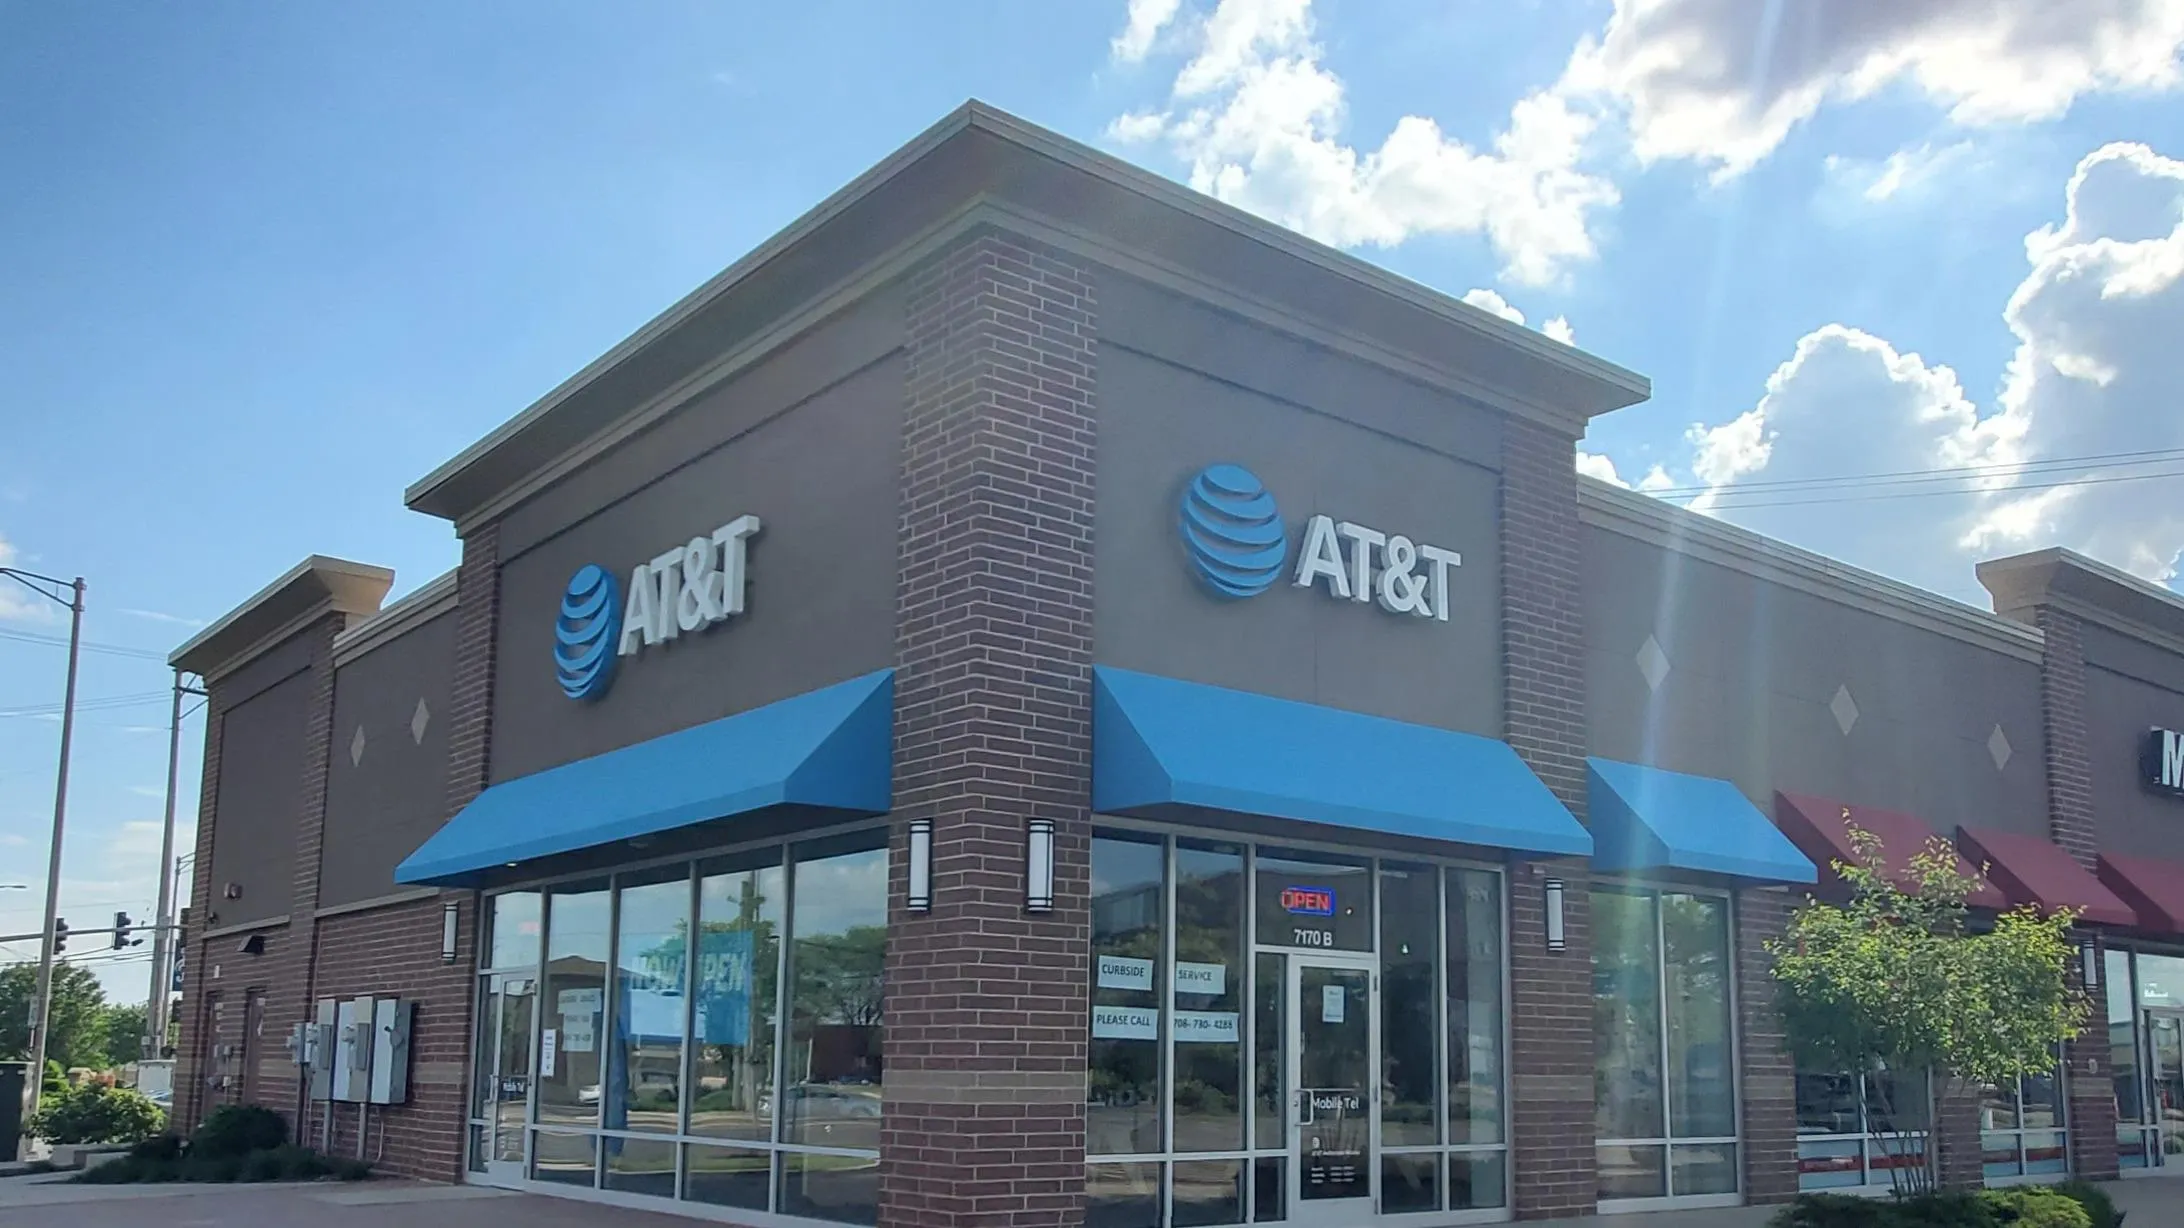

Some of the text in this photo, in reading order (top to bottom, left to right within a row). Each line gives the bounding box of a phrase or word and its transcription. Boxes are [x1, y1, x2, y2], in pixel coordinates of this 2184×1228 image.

[1292, 514, 1461, 622] AT&T
[617, 514, 760, 656] AT&T
[1281, 890, 1330, 911] OPEN
[1294, 928, 1332, 946] 7170 B
[695, 951, 748, 991] PEN
[1101, 964, 1213, 982] CURBSIDE SERVICE
[1096, 1013, 1150, 1027] PLEASE CALL
[1313, 1095, 1359, 1110] Mobile Tel
